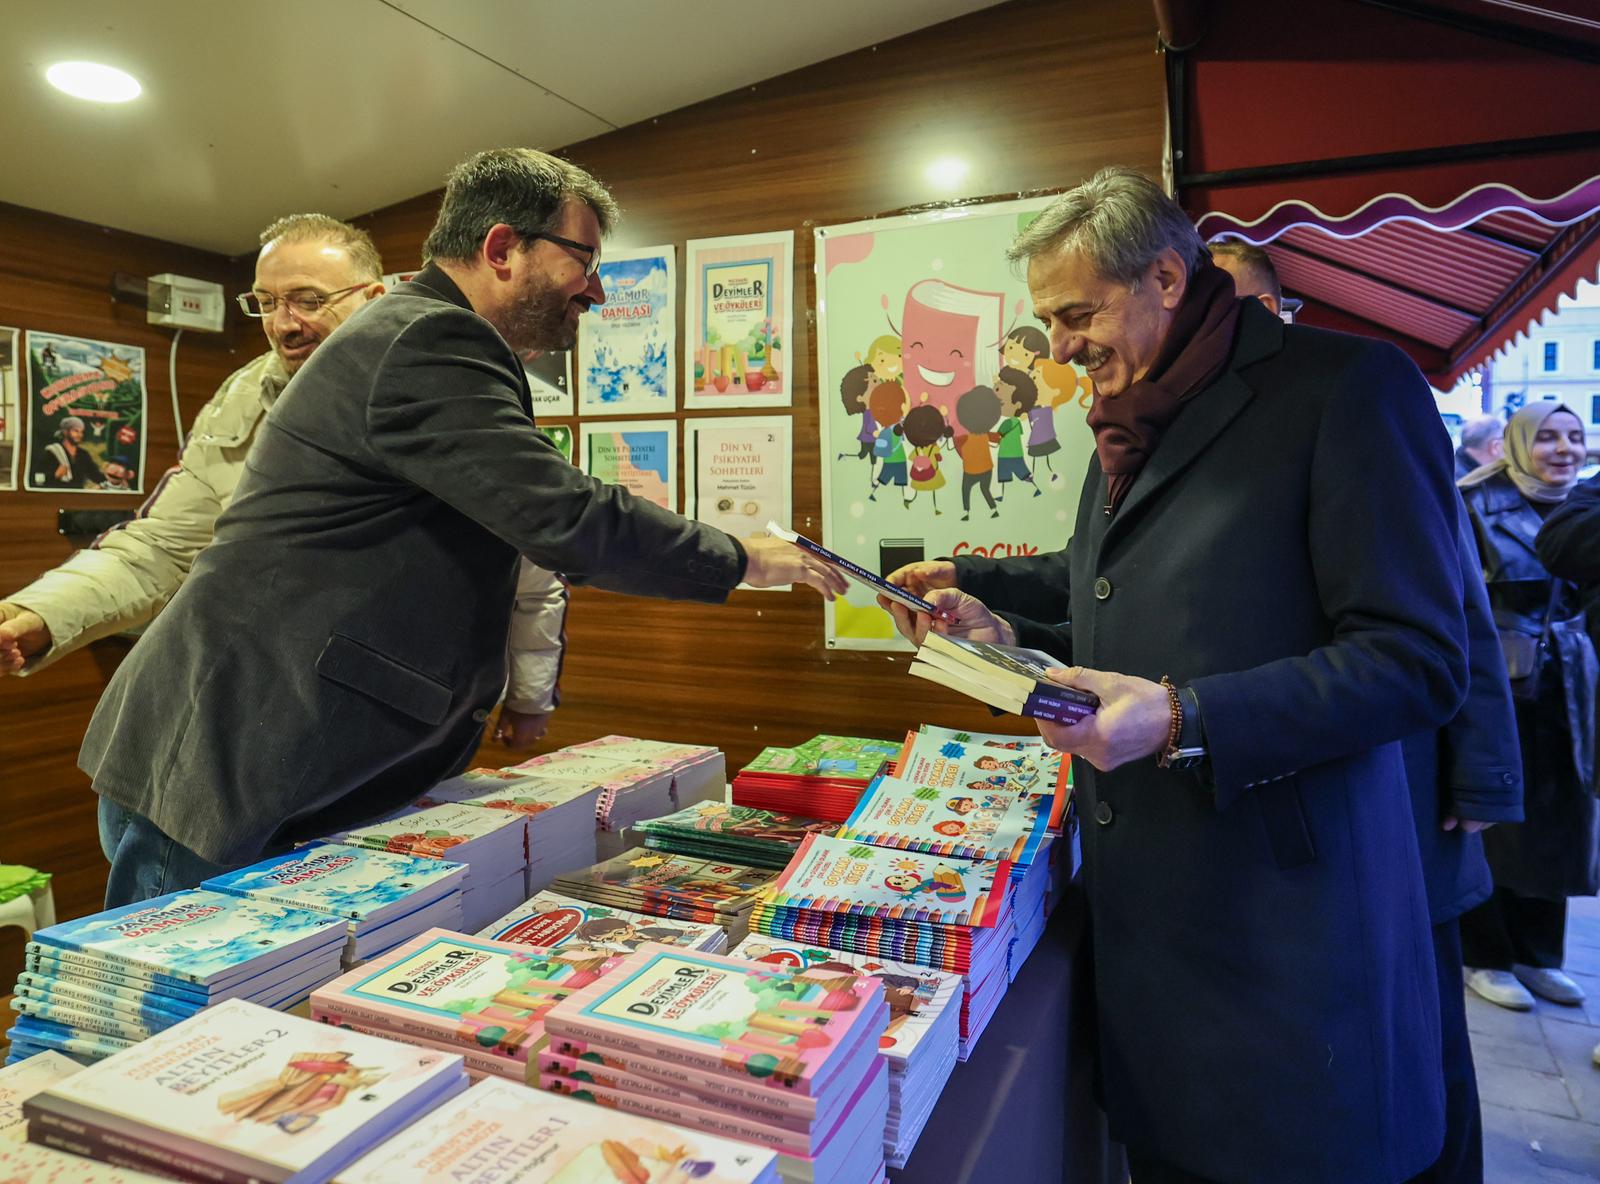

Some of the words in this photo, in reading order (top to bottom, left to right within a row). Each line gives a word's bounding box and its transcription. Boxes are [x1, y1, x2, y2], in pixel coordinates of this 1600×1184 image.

[601, 304, 651, 319] DAMLASI
[280, 856, 355, 887] DAMLASI
[123, 905, 220, 938] DAMLASI
[387, 950, 475, 994] DEYİMLER
[416, 986, 434, 998] VE
[433, 954, 489, 988] ÖYKÜLERİ
[627, 966, 706, 1016] DEYİMLER
[661, 1007, 679, 1020] VE
[677, 973, 722, 1010] ÖYKÜLERİ
[265, 1027, 289, 1041] 2
[155, 1046, 225, 1086] ALTIN
[450, 1134, 513, 1182] ALTIN
